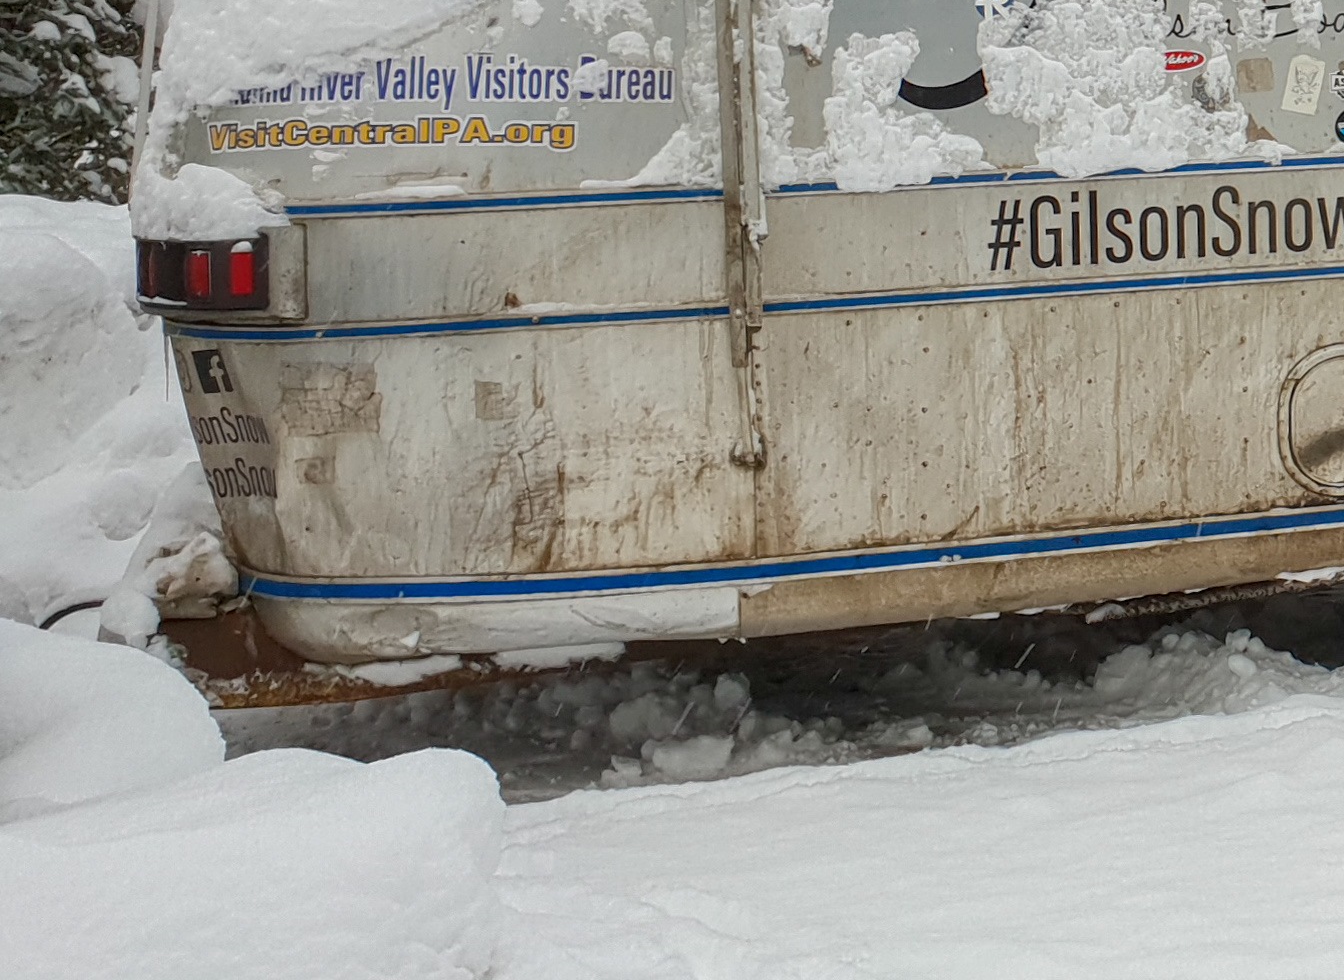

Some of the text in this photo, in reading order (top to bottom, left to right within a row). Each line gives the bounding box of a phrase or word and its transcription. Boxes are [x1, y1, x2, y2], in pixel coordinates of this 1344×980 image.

[376, 57, 457, 110] Valley
[466, 55, 570, 101] Visitors
[208, 117, 577, 151] VisitCentralPA.org
